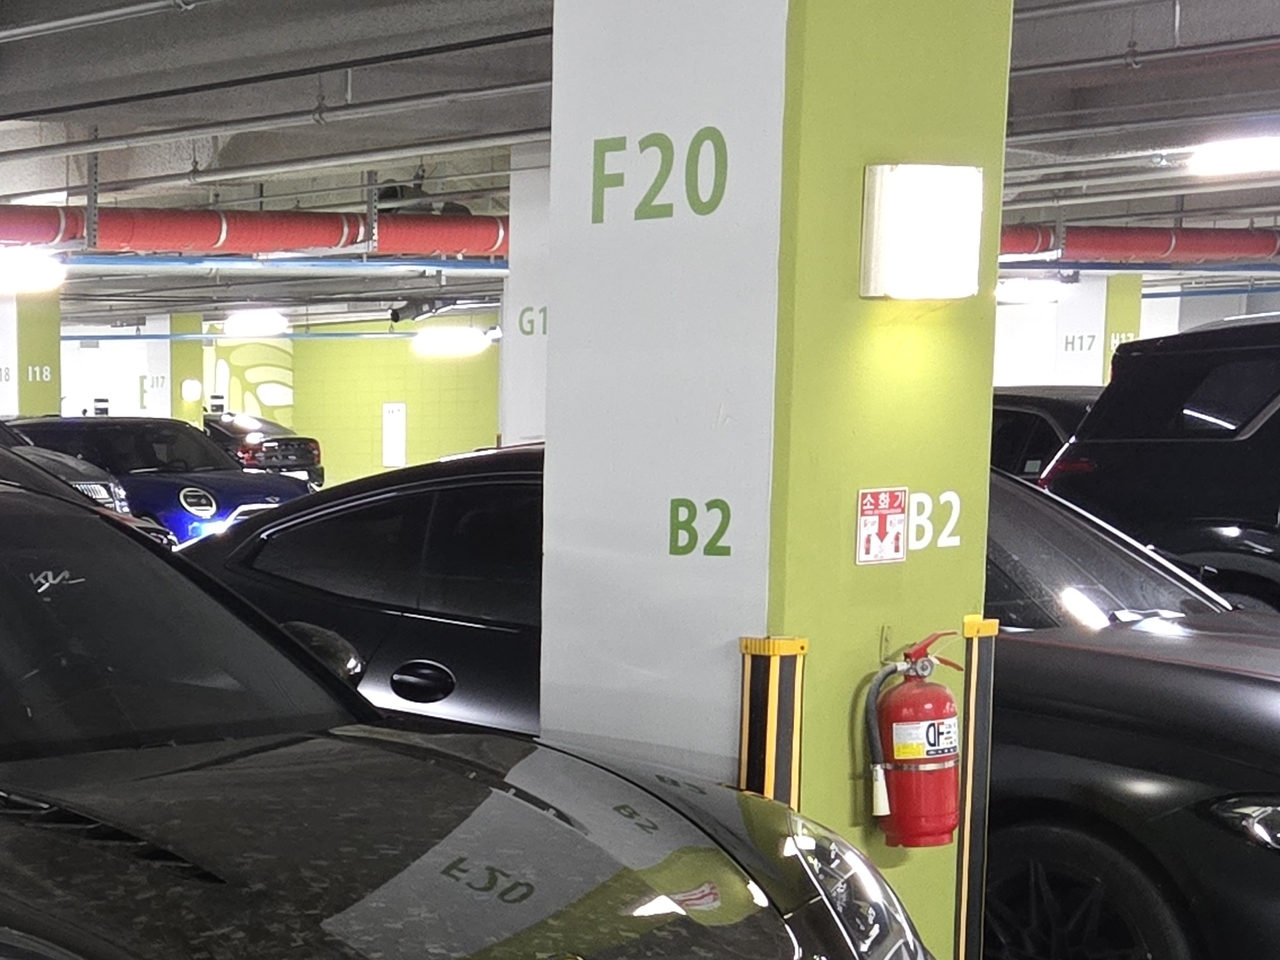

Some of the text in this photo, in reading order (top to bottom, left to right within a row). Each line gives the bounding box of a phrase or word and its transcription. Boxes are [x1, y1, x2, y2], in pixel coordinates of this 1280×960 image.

[591, 126, 728, 224] F20
[1064, 334, 1096, 351] H17
[28, 365, 51, 382] I18
[150, 375, 165, 388] J17
[669, 498, 731, 556] B2
[908, 490, 961, 550] B2
